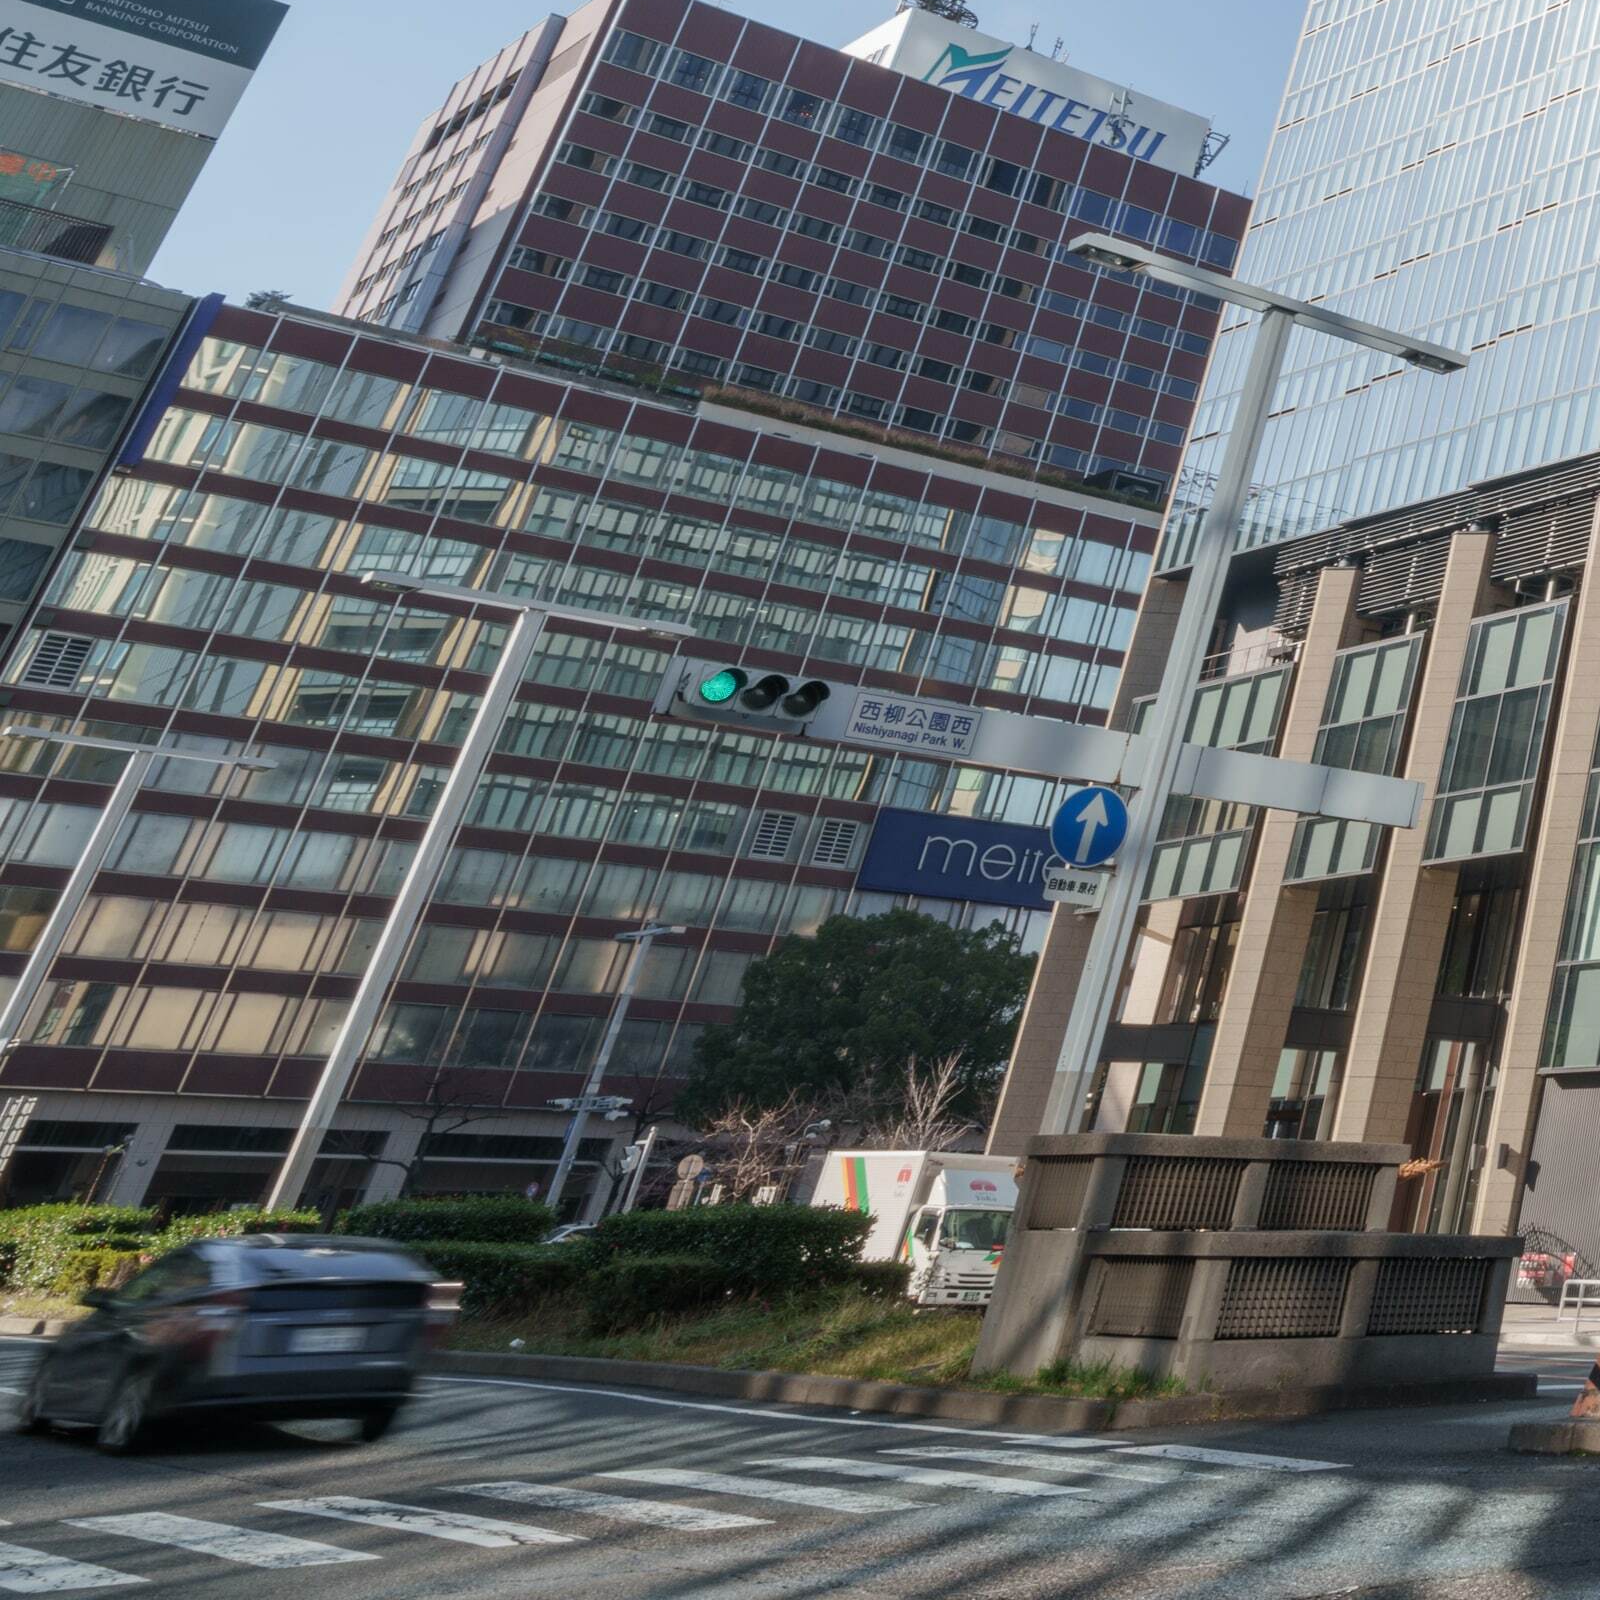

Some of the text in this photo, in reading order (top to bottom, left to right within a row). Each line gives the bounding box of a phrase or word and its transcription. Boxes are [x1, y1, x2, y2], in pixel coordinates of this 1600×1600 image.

[84, 2, 239, 54] BANKING CORPORATION
[166, 13, 210, 33] MITSUI
[0, 26, 210, 116] 住友銀行
[923, 43, 1168, 162] MEITETSU
[853, 722, 966, 750] Nishiyanagi Park W.
[859, 700, 974, 736] 西柳公園西
